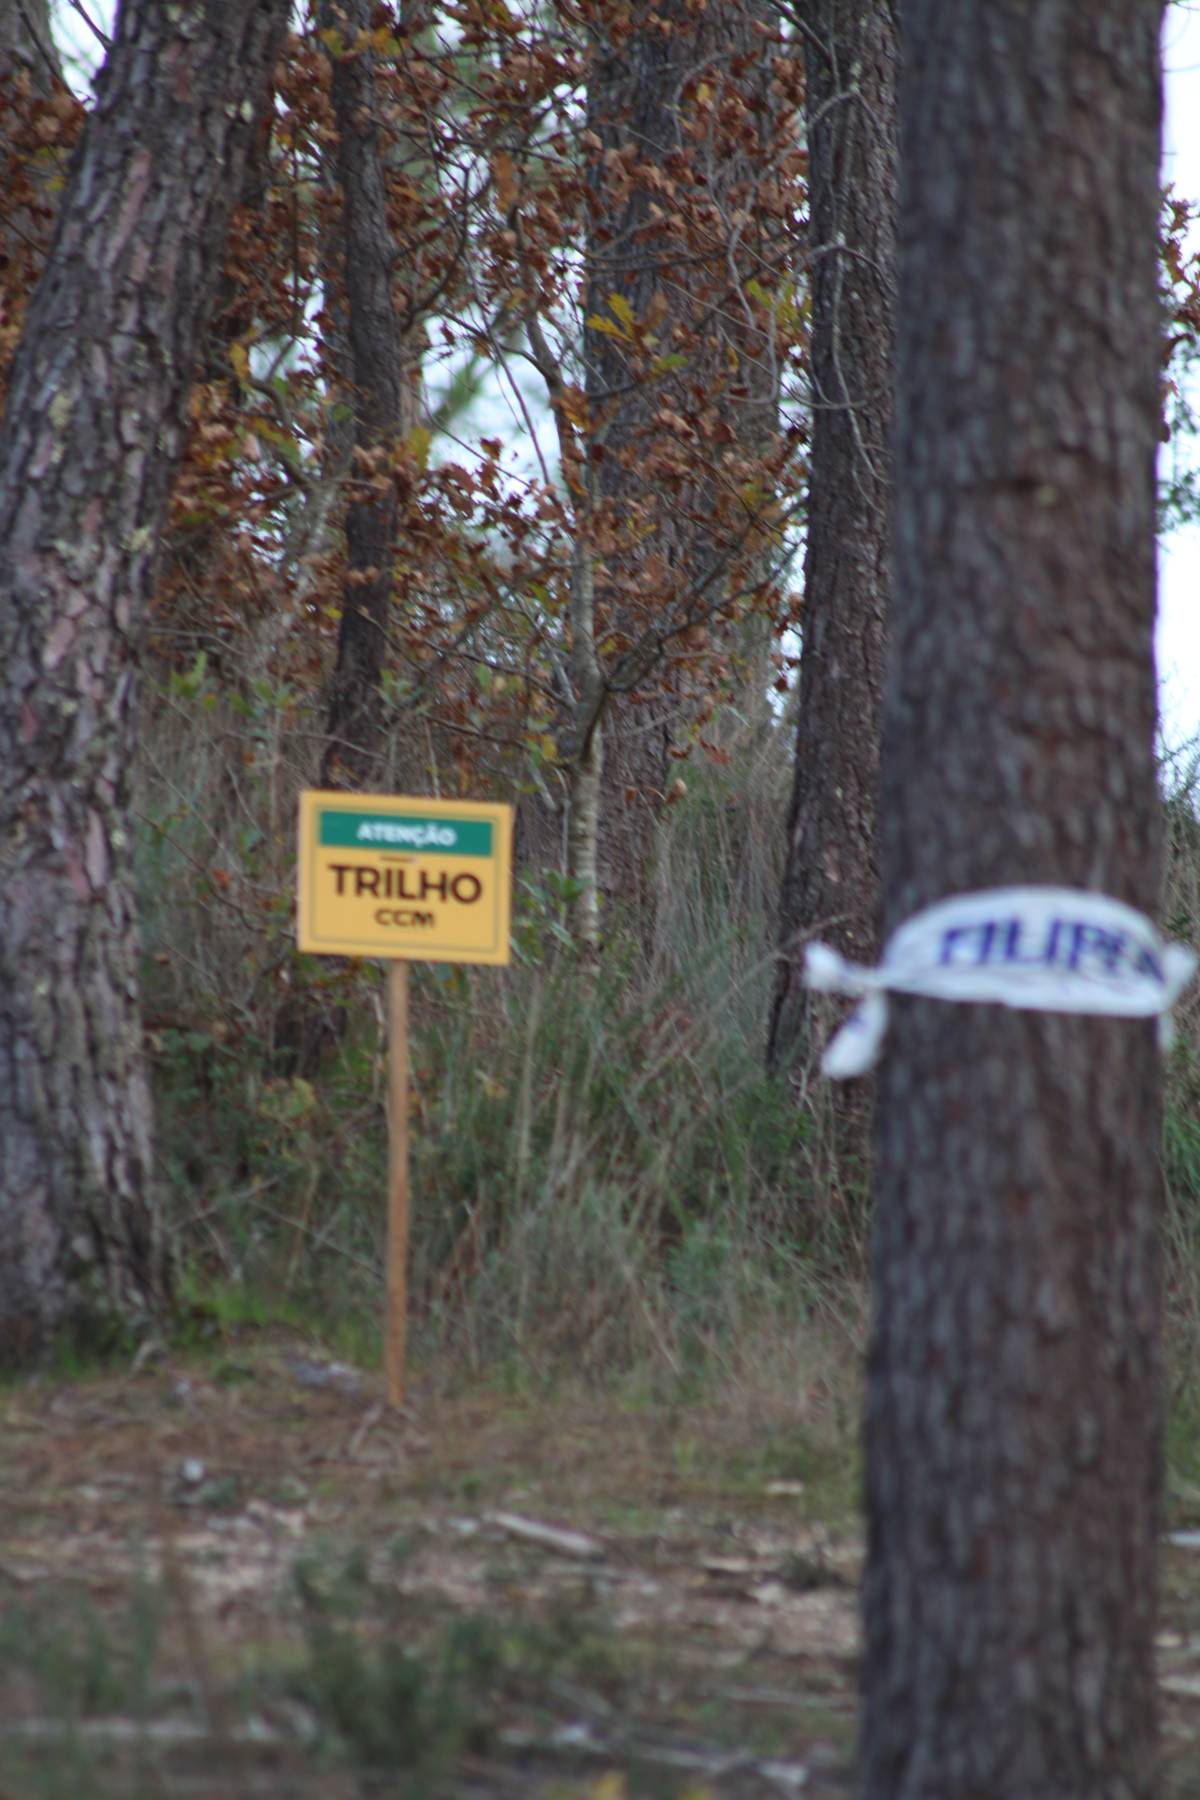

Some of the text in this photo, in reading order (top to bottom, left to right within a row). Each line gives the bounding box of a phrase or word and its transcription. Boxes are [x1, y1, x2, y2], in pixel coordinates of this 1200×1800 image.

[357, 822, 456, 847] ATENÇÃO
[328, 863, 482, 904] TRILHO
[374, 909, 434, 926] CCM
